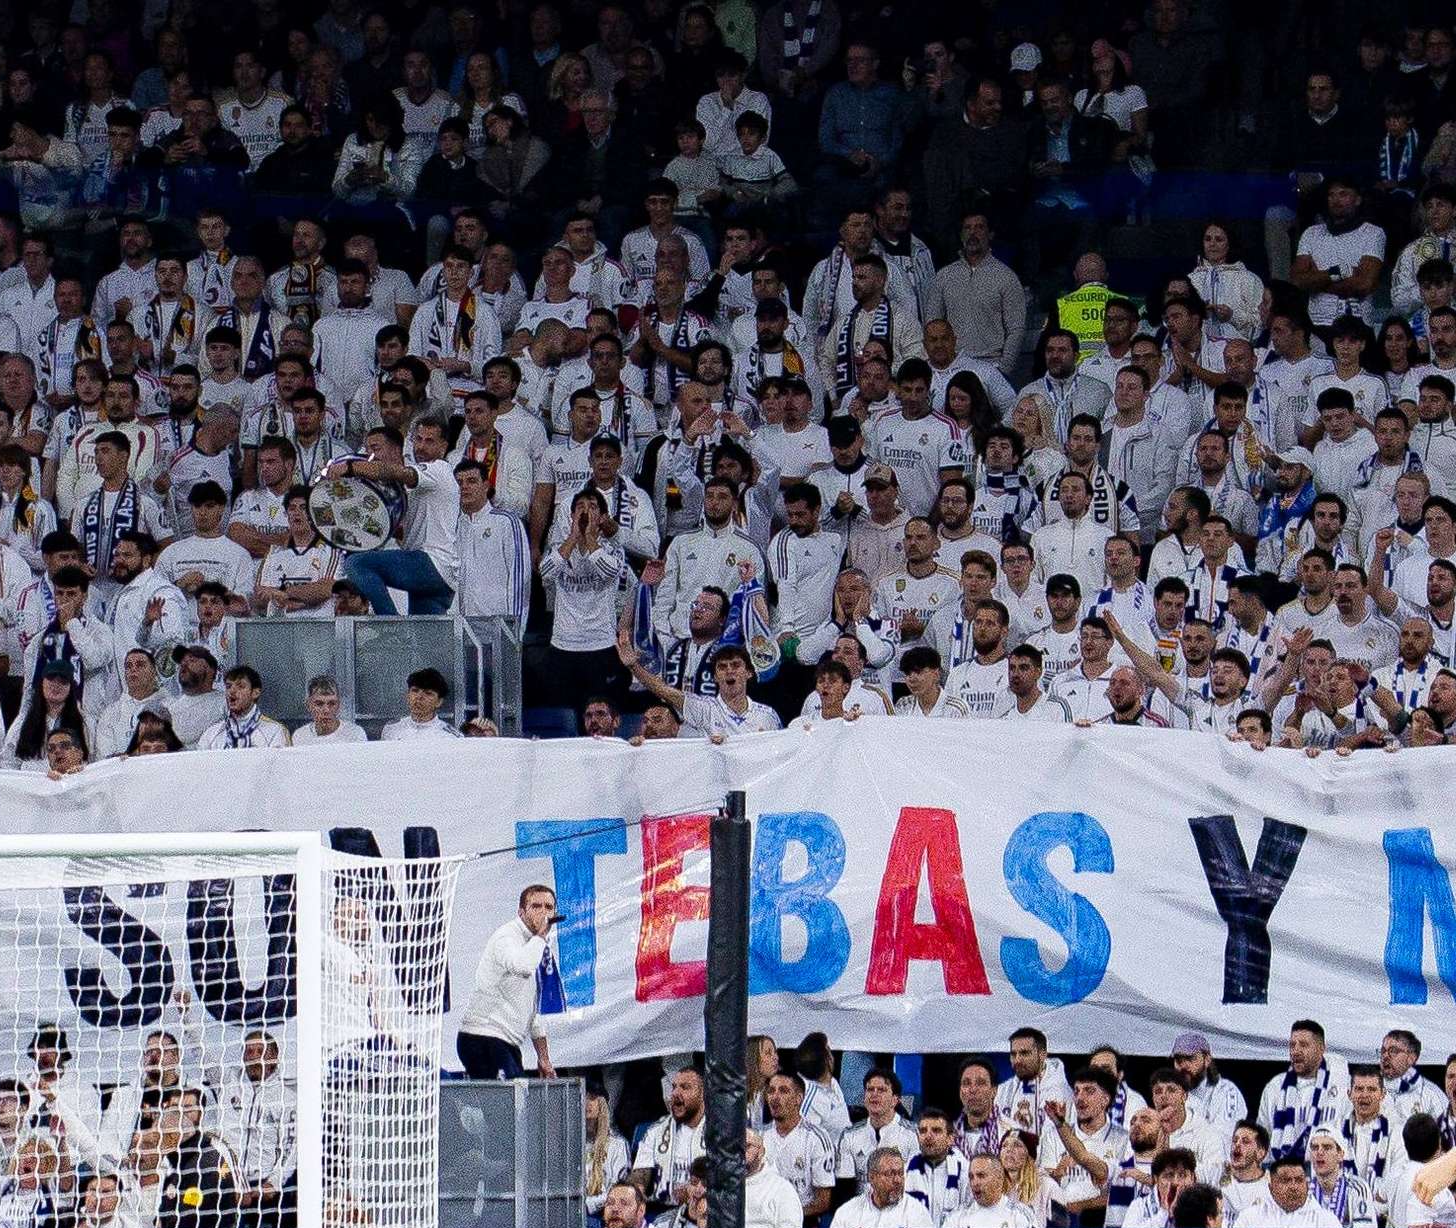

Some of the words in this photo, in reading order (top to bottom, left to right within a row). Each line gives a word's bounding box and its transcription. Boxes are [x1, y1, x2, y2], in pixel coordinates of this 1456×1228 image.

[62, 826, 451, 1028] SON
[514, 806, 1115, 1006] TEBAS
[1187, 814, 1308, 1005] Y
